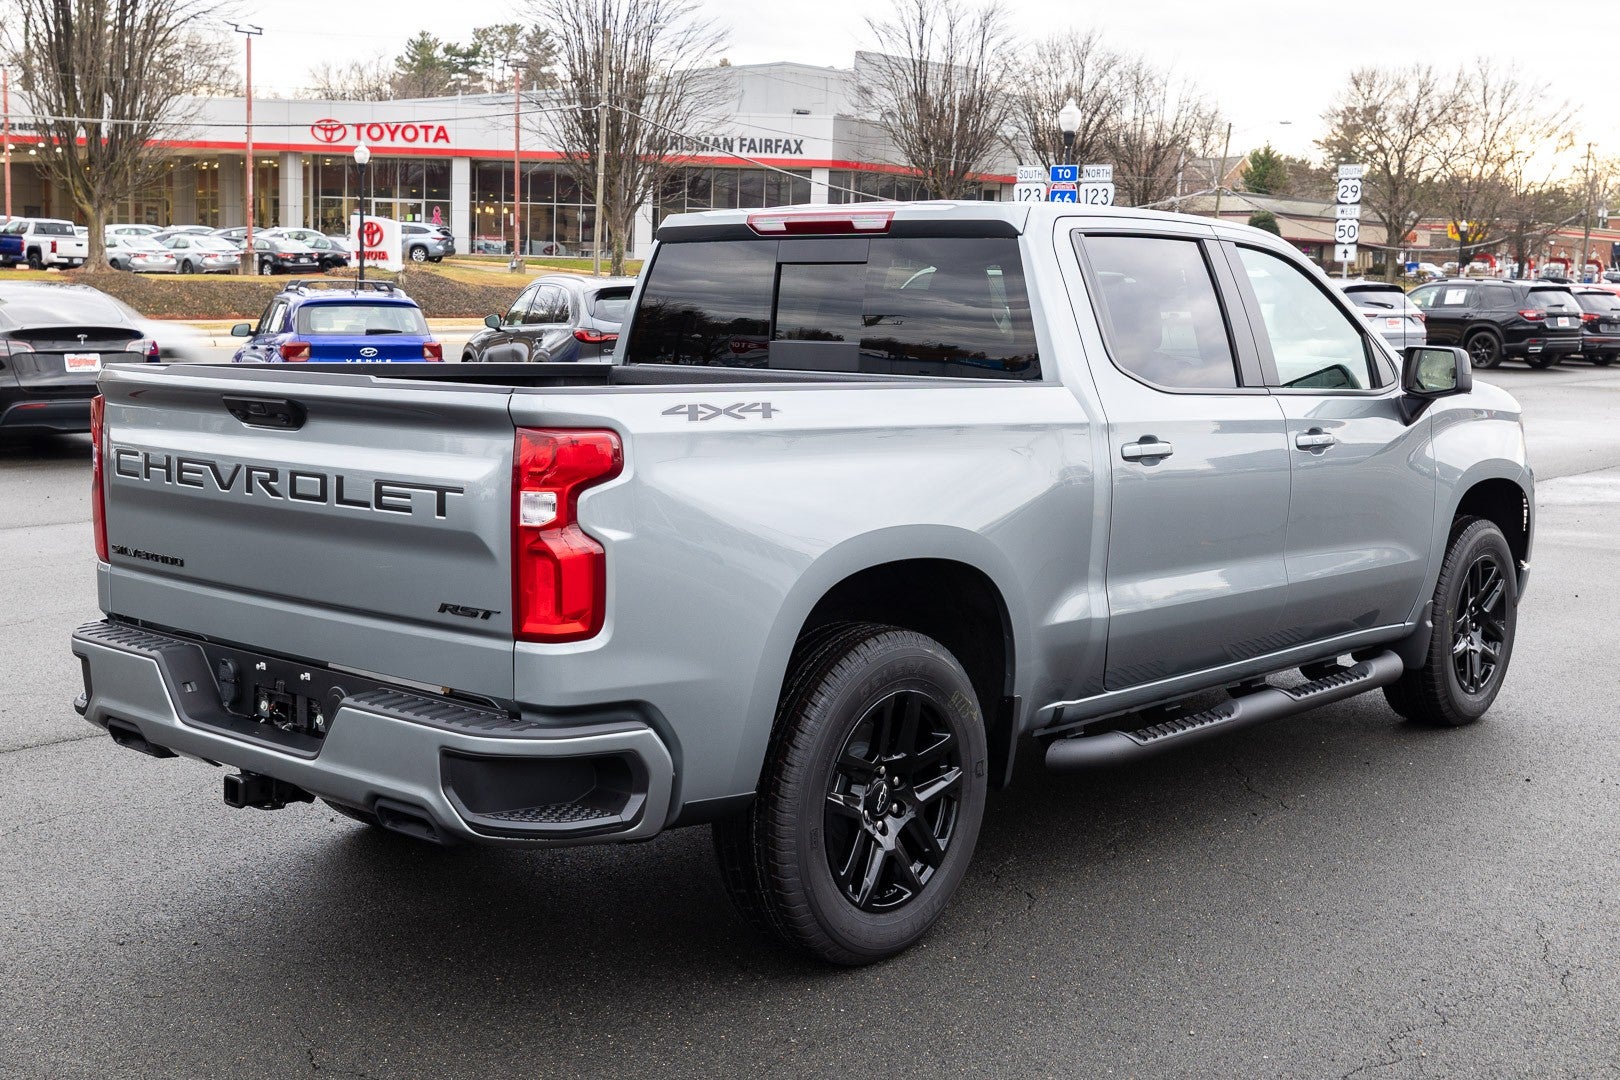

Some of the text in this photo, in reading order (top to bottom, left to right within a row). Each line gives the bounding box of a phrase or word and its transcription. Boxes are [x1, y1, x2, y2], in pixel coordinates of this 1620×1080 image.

[352, 122, 450, 143] TOYOTA
[739, 137, 804, 155] FAIRFAX
[1019, 169, 1043, 179] SOUTH
[1057, 169, 1071, 179] TO
[1085, 168, 1110, 180] NORTH
[1340, 167, 1362, 176] SOUTH
[1018, 188, 1041, 202] 123
[1053, 192, 1072, 203] 66
[1085, 188, 1109, 205] 123
[1340, 184, 1359, 199] 29
[1340, 208, 1356, 217] WEST
[1338, 225, 1356, 239] 50
[115, 448, 464, 519] CHEVROLET
[111, 544, 185, 567] SILVERADO
[437, 602, 501, 621] RST
